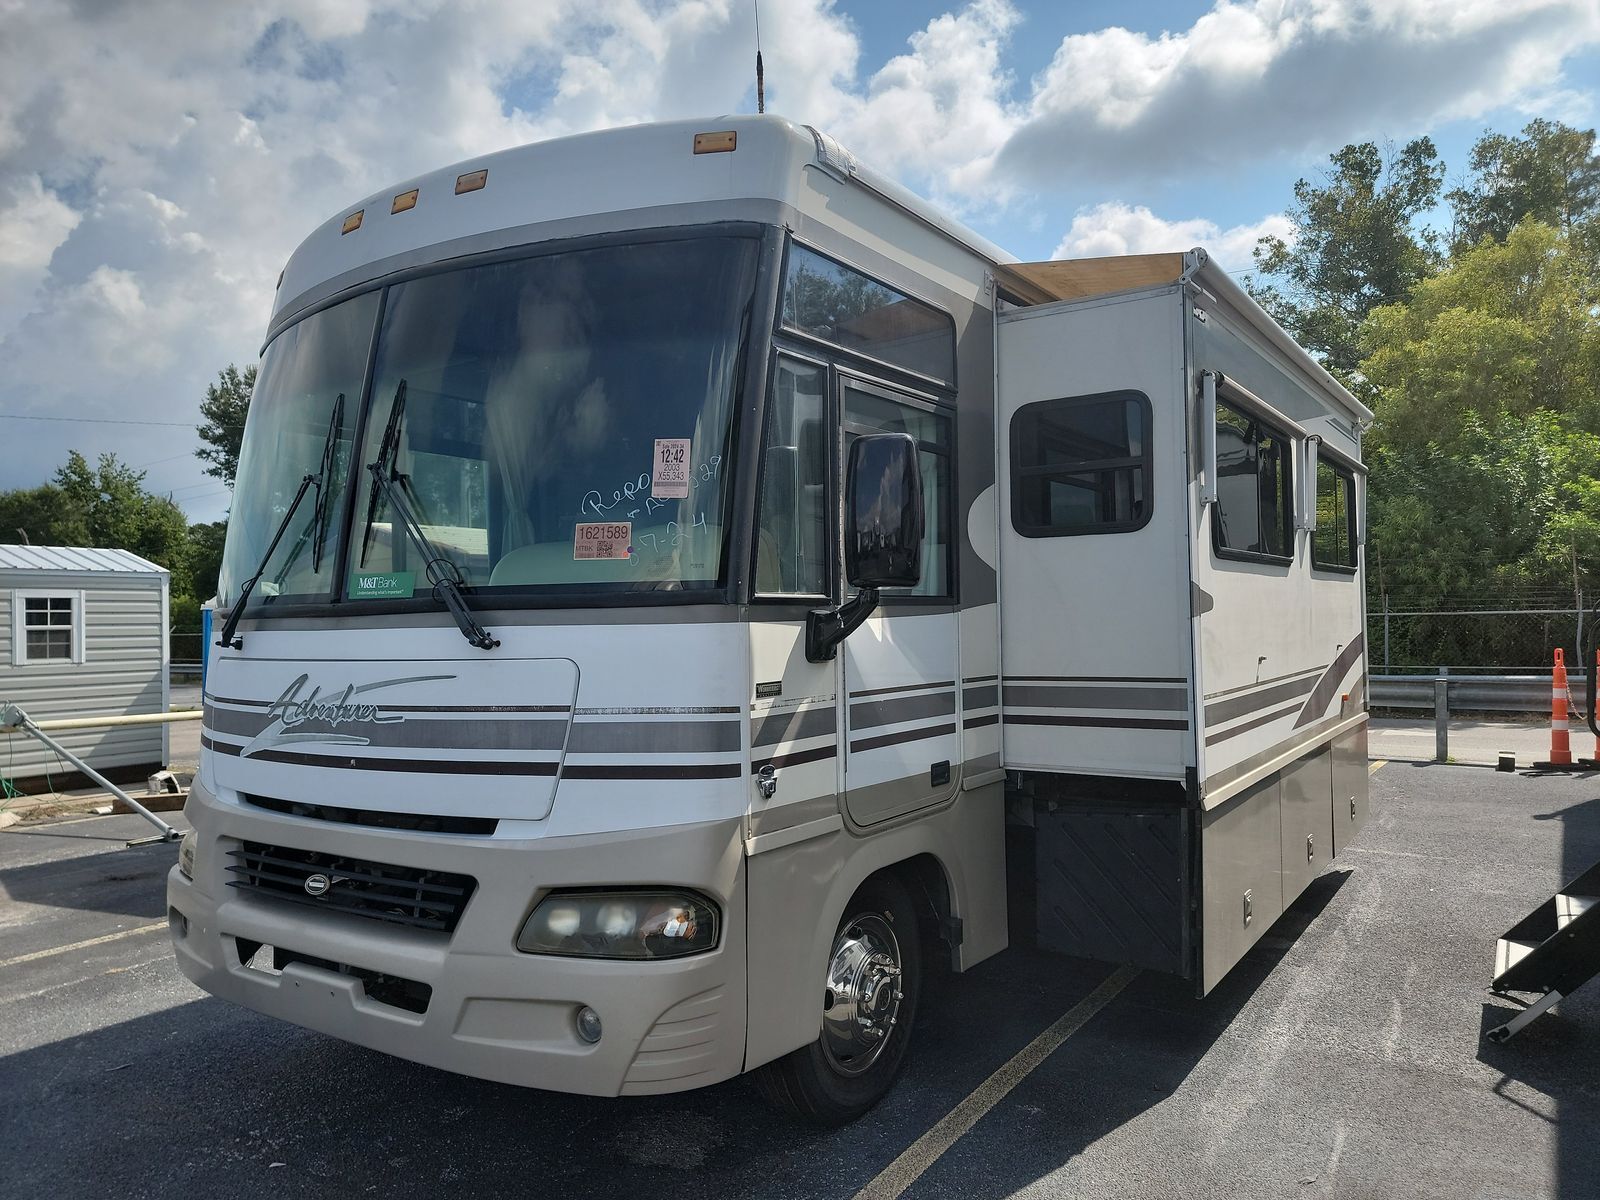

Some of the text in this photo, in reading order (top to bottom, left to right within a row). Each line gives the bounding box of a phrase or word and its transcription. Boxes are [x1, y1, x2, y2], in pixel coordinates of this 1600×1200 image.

[660, 449, 685, 463] 12:42
[663, 463, 681, 471] 2003
[579, 525, 629, 540] 1621589
[358, 576, 398, 589] M&T Bank
[268, 673, 404, 727] Adventurer
